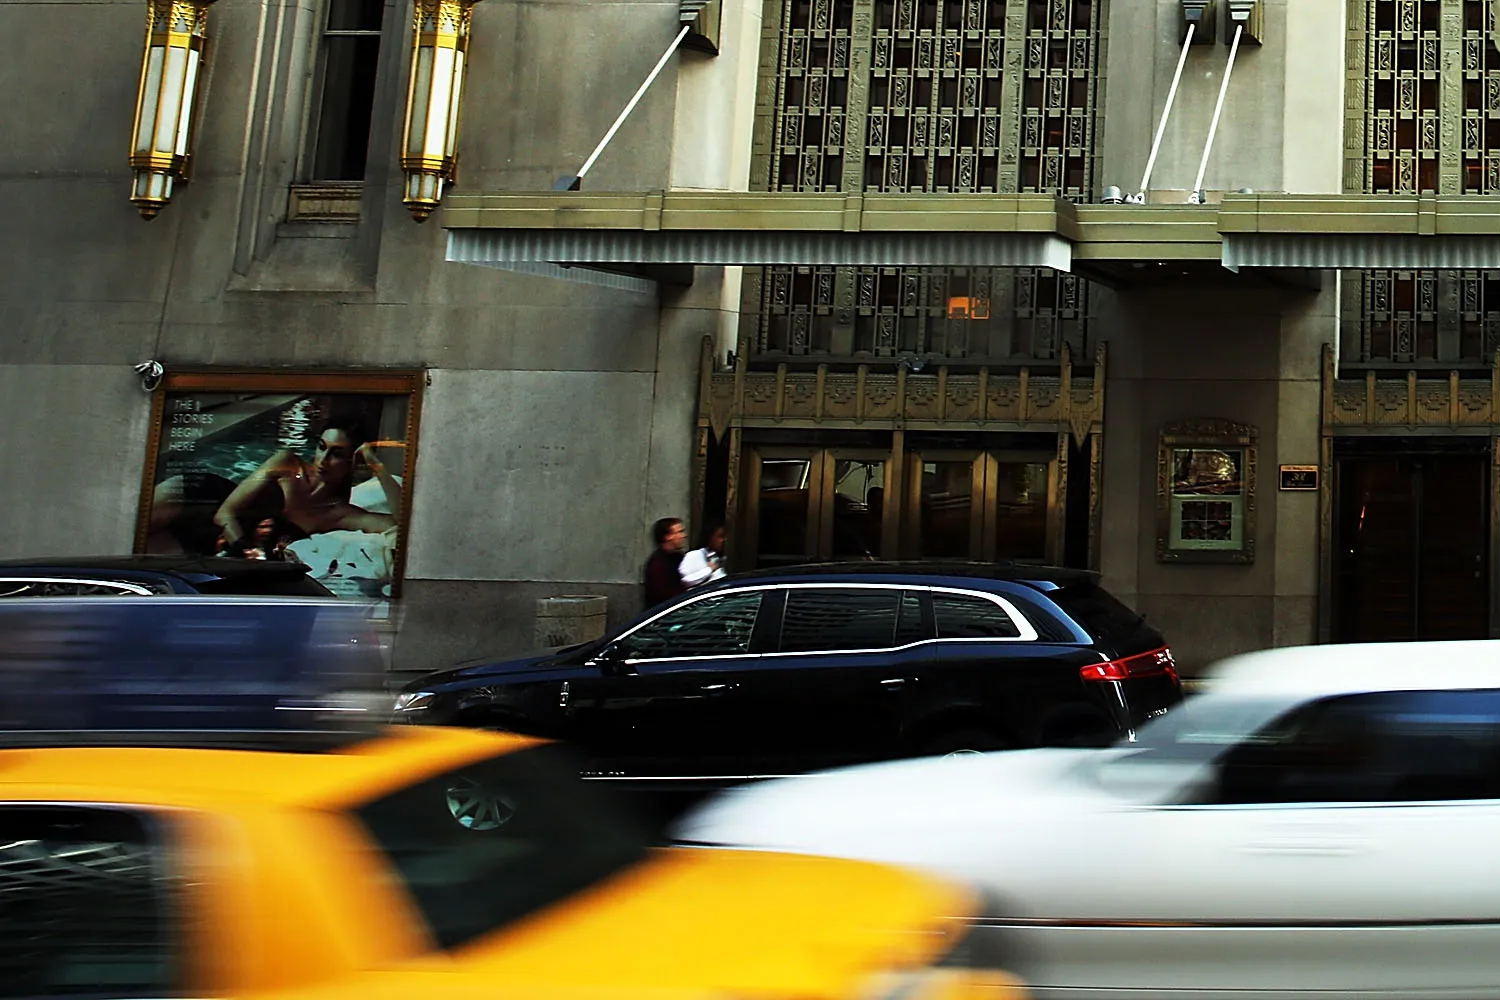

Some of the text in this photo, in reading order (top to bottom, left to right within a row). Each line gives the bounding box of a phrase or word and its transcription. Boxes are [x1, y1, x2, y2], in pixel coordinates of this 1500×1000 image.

[172, 413, 214, 424] STORIES
[170, 427, 204, 438] BEGIN
[168, 441, 196, 452] HERE
